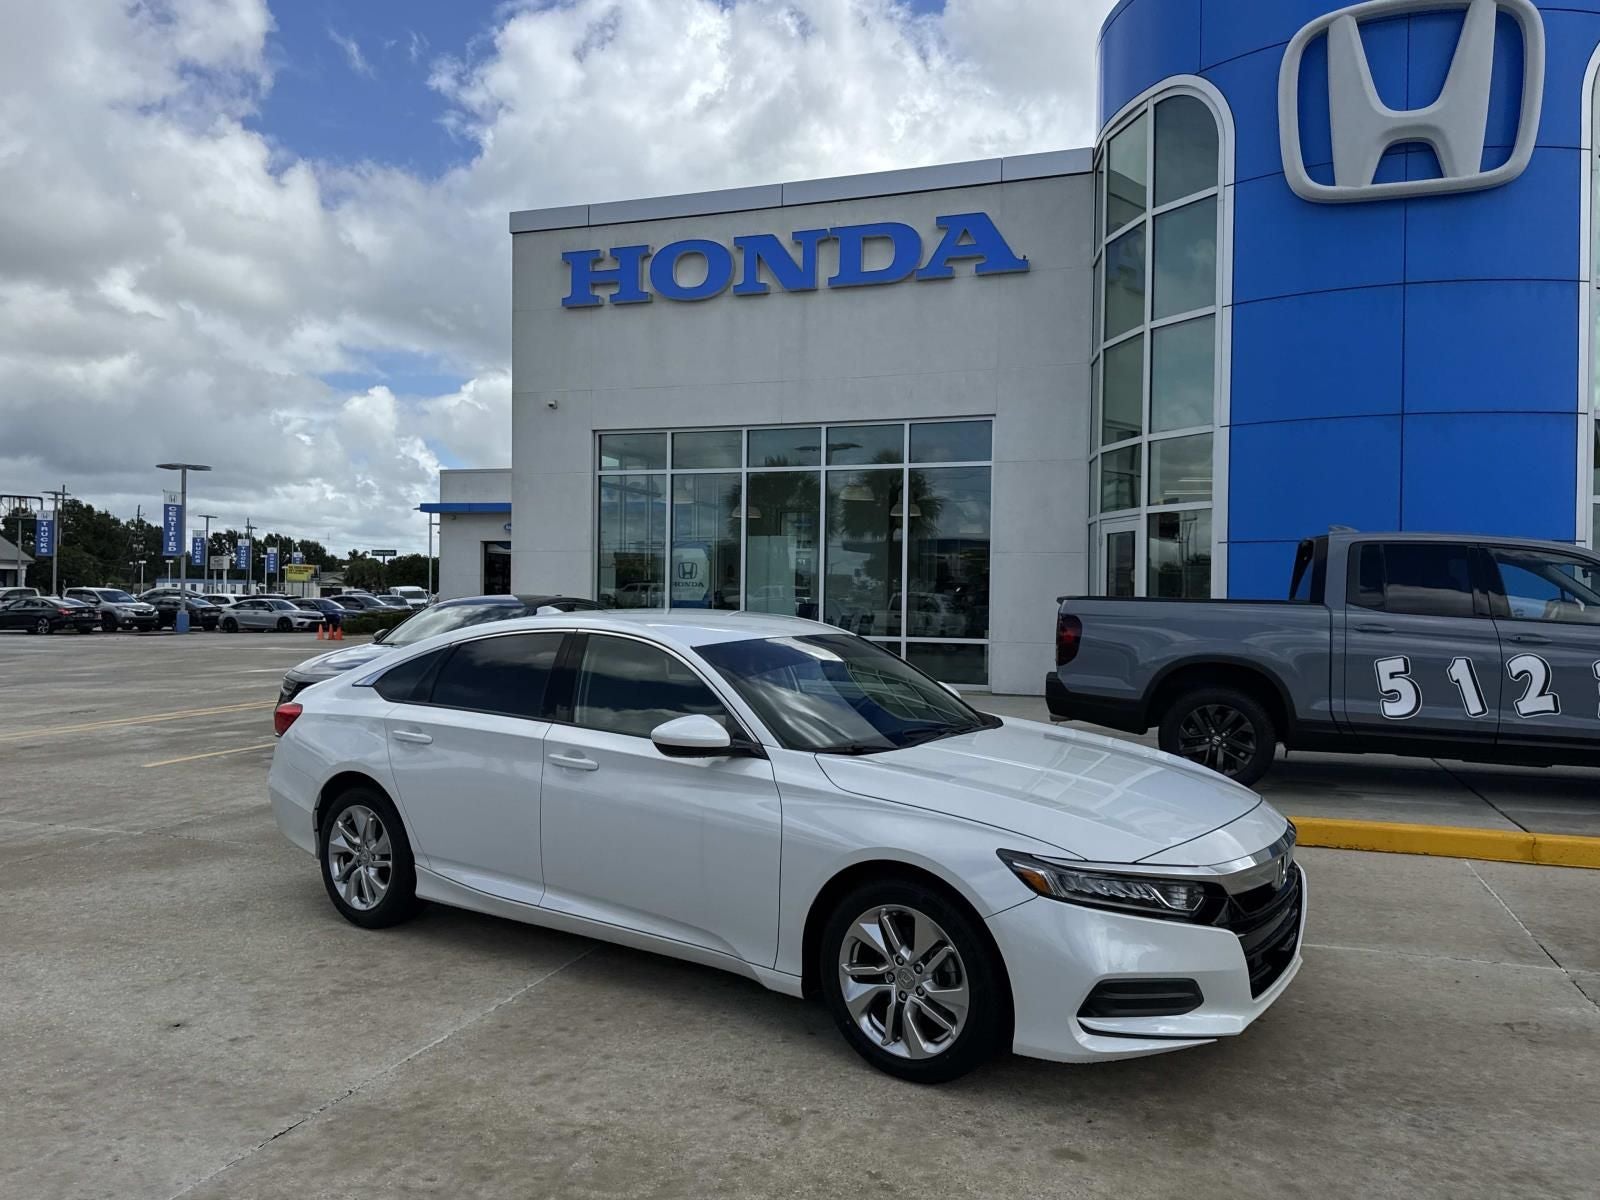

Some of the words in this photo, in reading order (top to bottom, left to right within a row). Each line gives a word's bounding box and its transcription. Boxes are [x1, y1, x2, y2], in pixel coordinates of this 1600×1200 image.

[562, 212, 1029, 308] HONDA
[40, 521, 49, 553] TRUCKS
[168, 506, 177, 552] CERTIFIED
[194, 538, 202, 563] TRUCKS
[1374, 652, 1600, 720] 512
